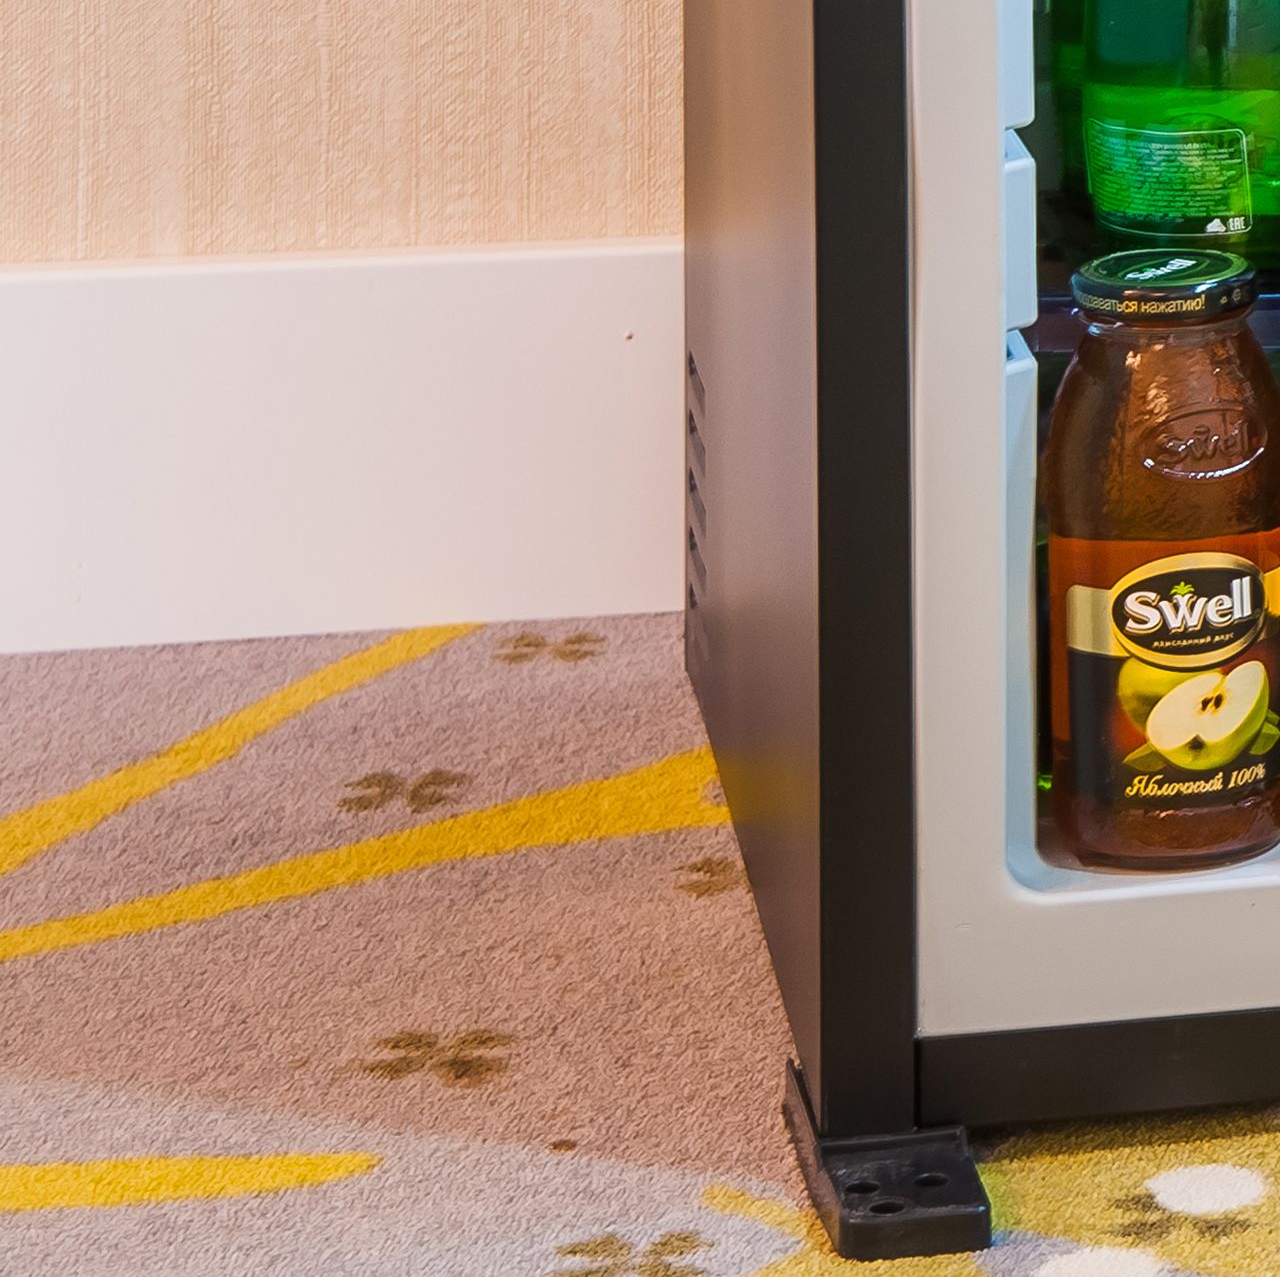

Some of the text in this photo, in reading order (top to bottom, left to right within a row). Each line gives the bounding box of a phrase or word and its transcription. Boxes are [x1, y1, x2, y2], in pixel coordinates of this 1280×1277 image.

[1124, 258, 1198, 280] Swell
[1141, 294, 1206, 314] нажатию!
[1124, 576, 1252, 633] Swell
[1125, 763, 1267, 798] Яблочный 100%
